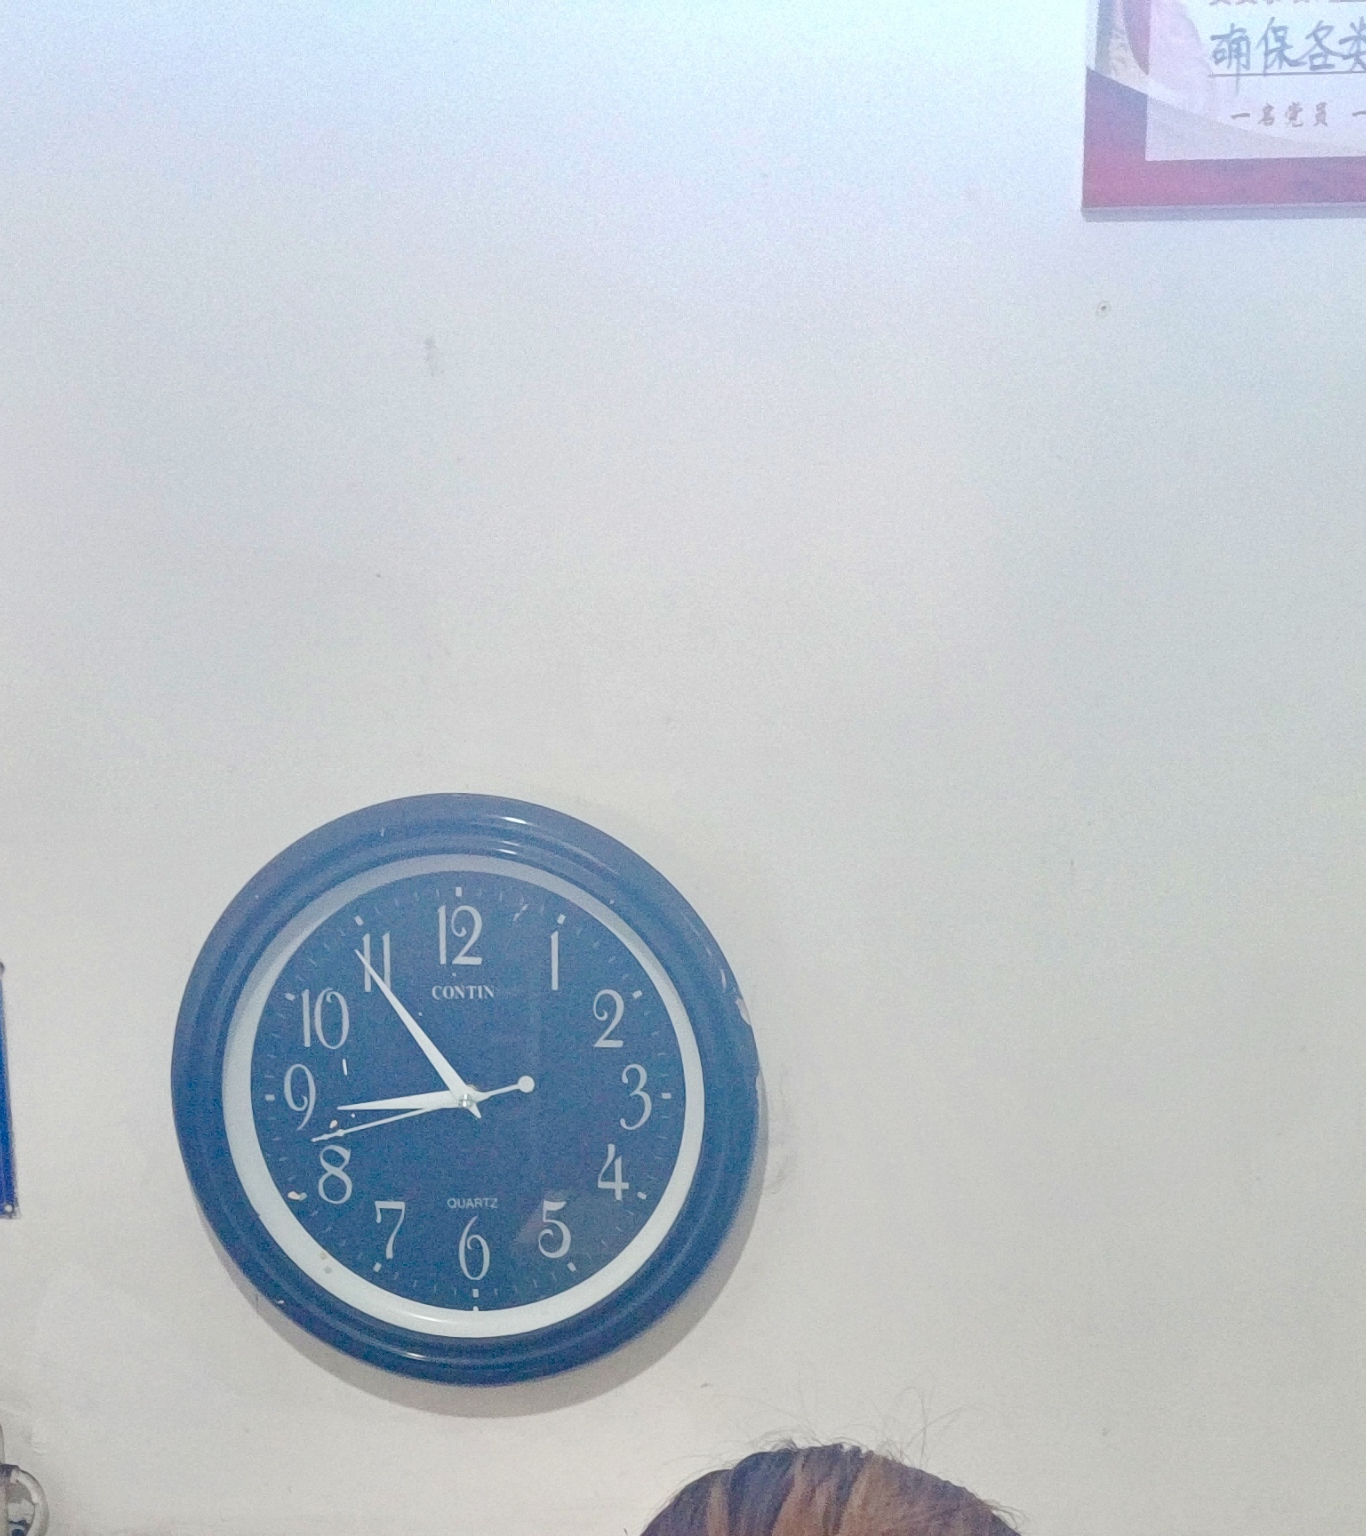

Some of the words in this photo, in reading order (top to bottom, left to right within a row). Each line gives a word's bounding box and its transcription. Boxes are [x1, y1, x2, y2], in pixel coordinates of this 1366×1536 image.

[362, 931, 392, 993] 11
[438, 905, 483, 965] 12
[550, 930, 560, 991] 1
[302, 987, 351, 1050] 10
[431, 985, 495, 1000] CONTIN
[592, 989, 625, 1048] 2
[283, 1064, 316, 1131] 9
[619, 1063, 653, 1131] 3
[318, 1145, 353, 1204] 8
[597, 1143, 630, 1201] 4
[375, 1200, 406, 1259] 7
[446, 1197, 499, 1209] QUARTZ
[537, 1199, 572, 1259] 5
[458, 1215, 491, 1281] 6
